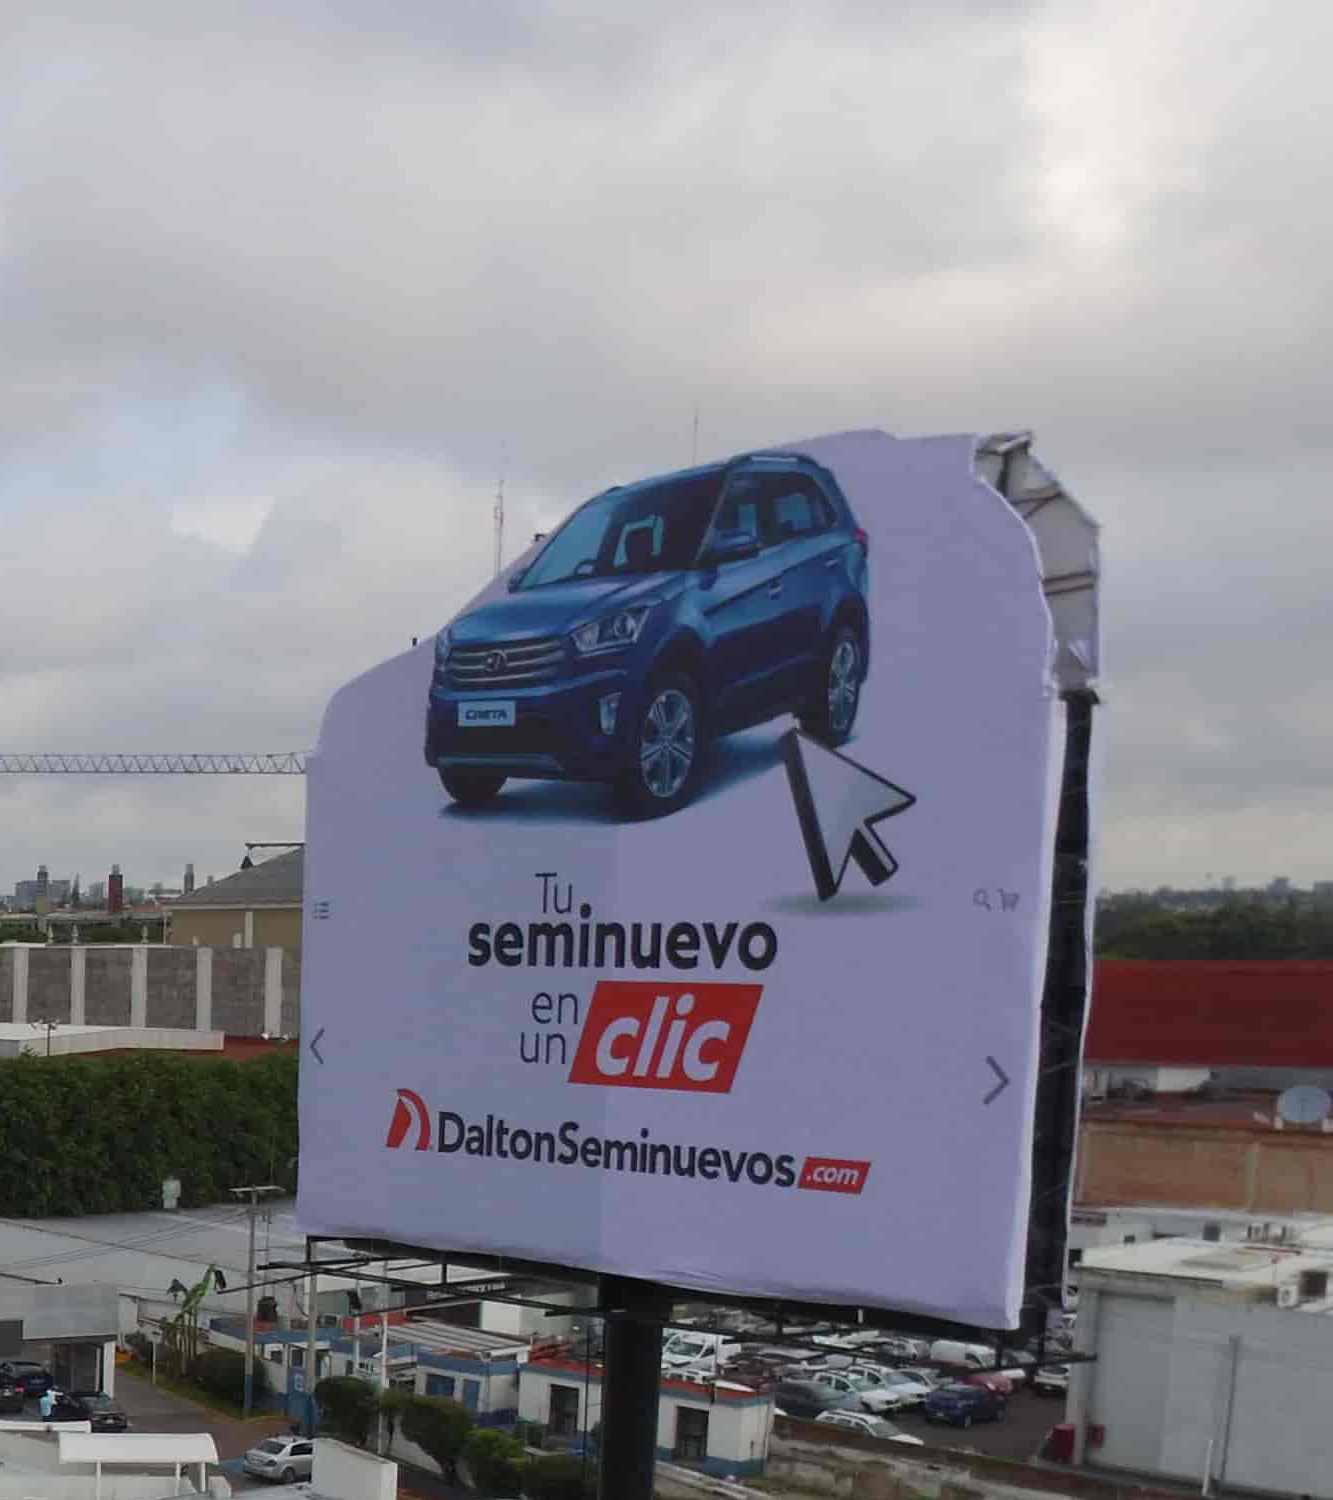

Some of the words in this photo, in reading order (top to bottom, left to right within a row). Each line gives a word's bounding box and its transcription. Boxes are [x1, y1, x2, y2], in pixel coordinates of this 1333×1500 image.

[536, 873, 572, 914] Tu
[468, 905, 778, 971] seminuevo
[533, 992, 580, 1025] en
[520, 1030, 567, 1065] un
[594, 994, 731, 1082] clic
